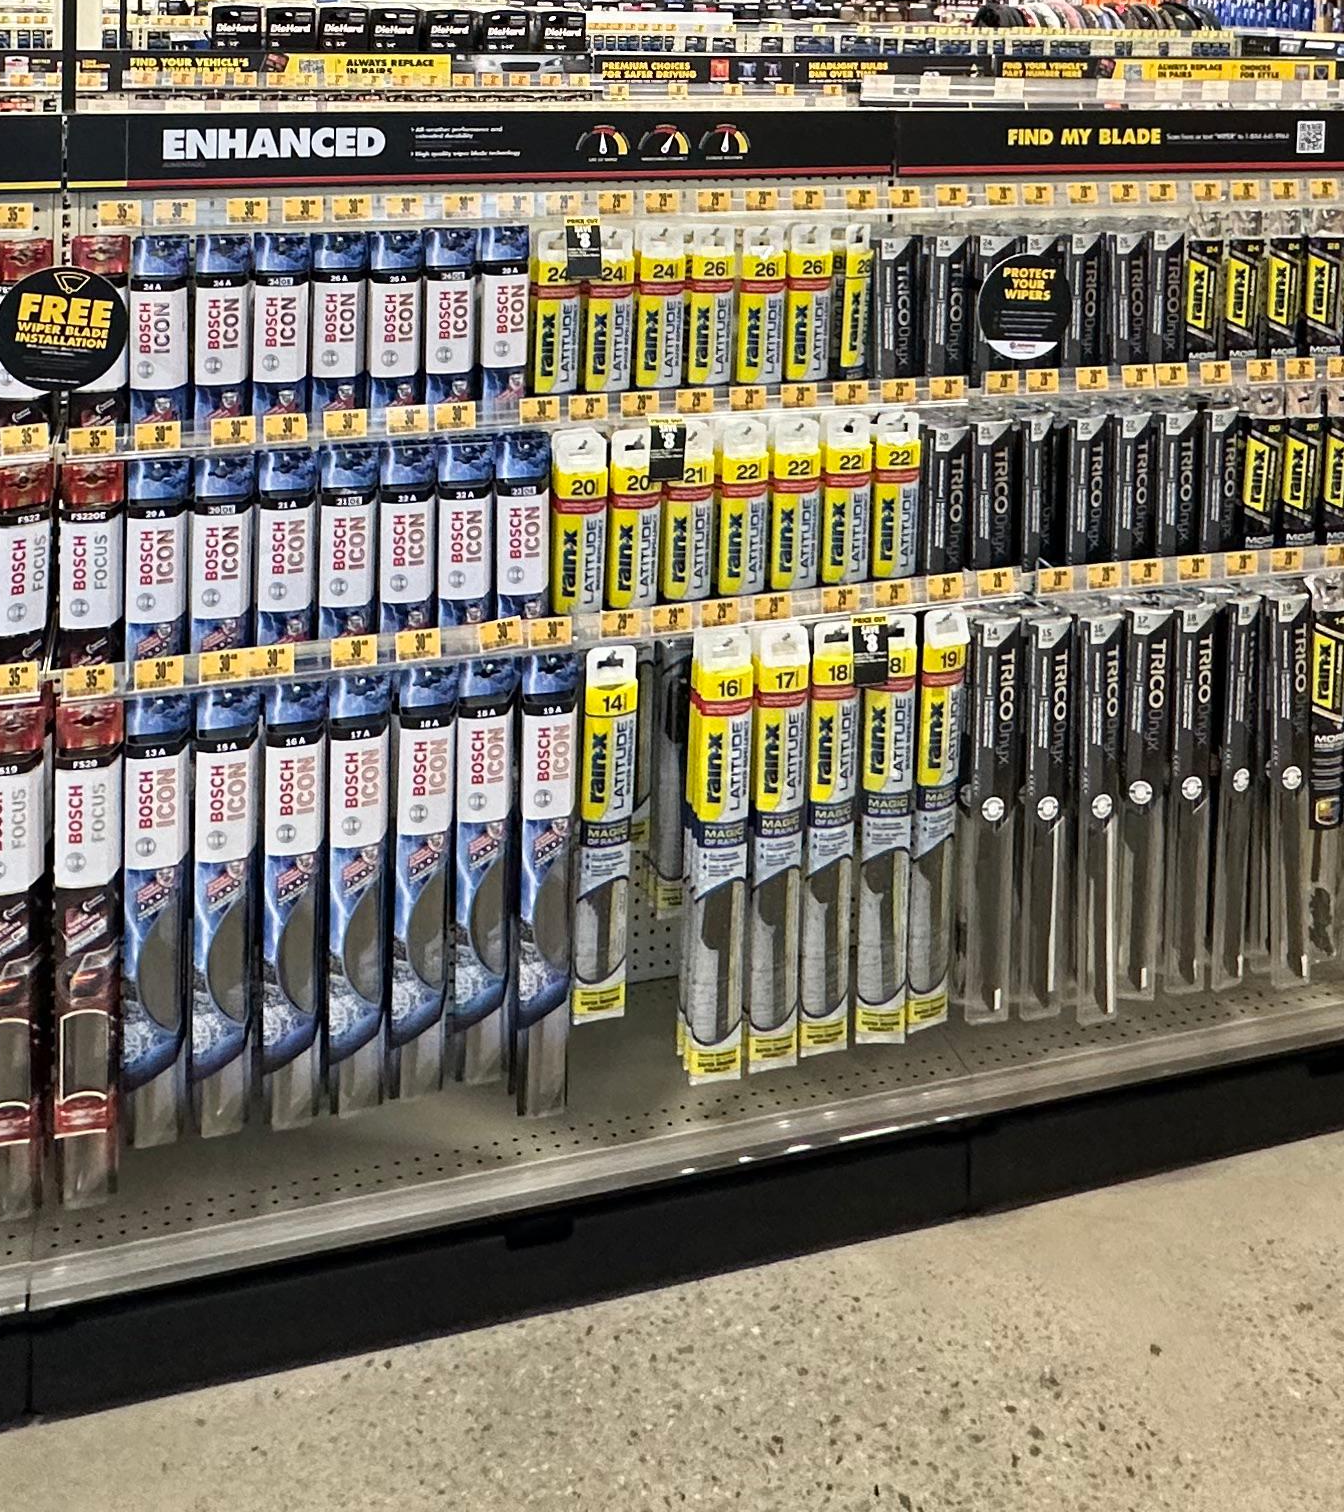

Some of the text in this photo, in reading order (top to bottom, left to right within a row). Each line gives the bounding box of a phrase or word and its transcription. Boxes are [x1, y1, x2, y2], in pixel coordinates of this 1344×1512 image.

[130, 58, 156, 67] FIND
[161, 58, 191, 67] YOUR
[346, 59, 435, 67] ALWAYS REPLACE
[602, 62, 690, 70] PREMIUM CHOICES
[602, 71, 621, 79] FOR
[162, 127, 386, 160] ENHANCED
[1007, 129, 1053, 145] FIND
[1061, 129, 1092, 145] MY
[1099, 128, 1161, 145] BLADE
[653, 265, 674, 279] 24
[704, 261, 725, 276] 26
[803, 260, 823, 275] 26
[1003, 267, 1056, 279] PROTECT
[1012, 278, 1045, 289] YOUR
[1004, 289, 1051, 301] WIPERS
[18, 293, 114, 328] FREE
[339, 292, 355, 343] ICON
[17, 322, 109, 339] WIPER BLADE
[15, 332, 107, 349] INSTALLATION
[889, 451, 910, 466] 22
[736, 464, 758, 480] 22
[571, 480, 596, 496] 20
[73, 536, 87, 591] BOSCH
[94, 534, 108, 590] FOCUS
[940, 651, 958, 668] 19
[1148, 637, 1166, 708] TRICO
[718, 680, 738, 697] 16
[602, 695, 622, 712] 14
[350, 729, 371, 739] 17 A
[893, 698, 905, 783] LATITUDE
[157, 748, 166, 757] A
[72, 759, 99, 769] FS20
[613, 721, 628, 809] LATITUDE
[361, 748, 380, 807] ICON
[139, 770, 153, 830] BOSCH
[157, 767, 176, 829] ICON
[868, 798, 908, 809] MAGIC
[69, 784, 83, 844] BOSCH
